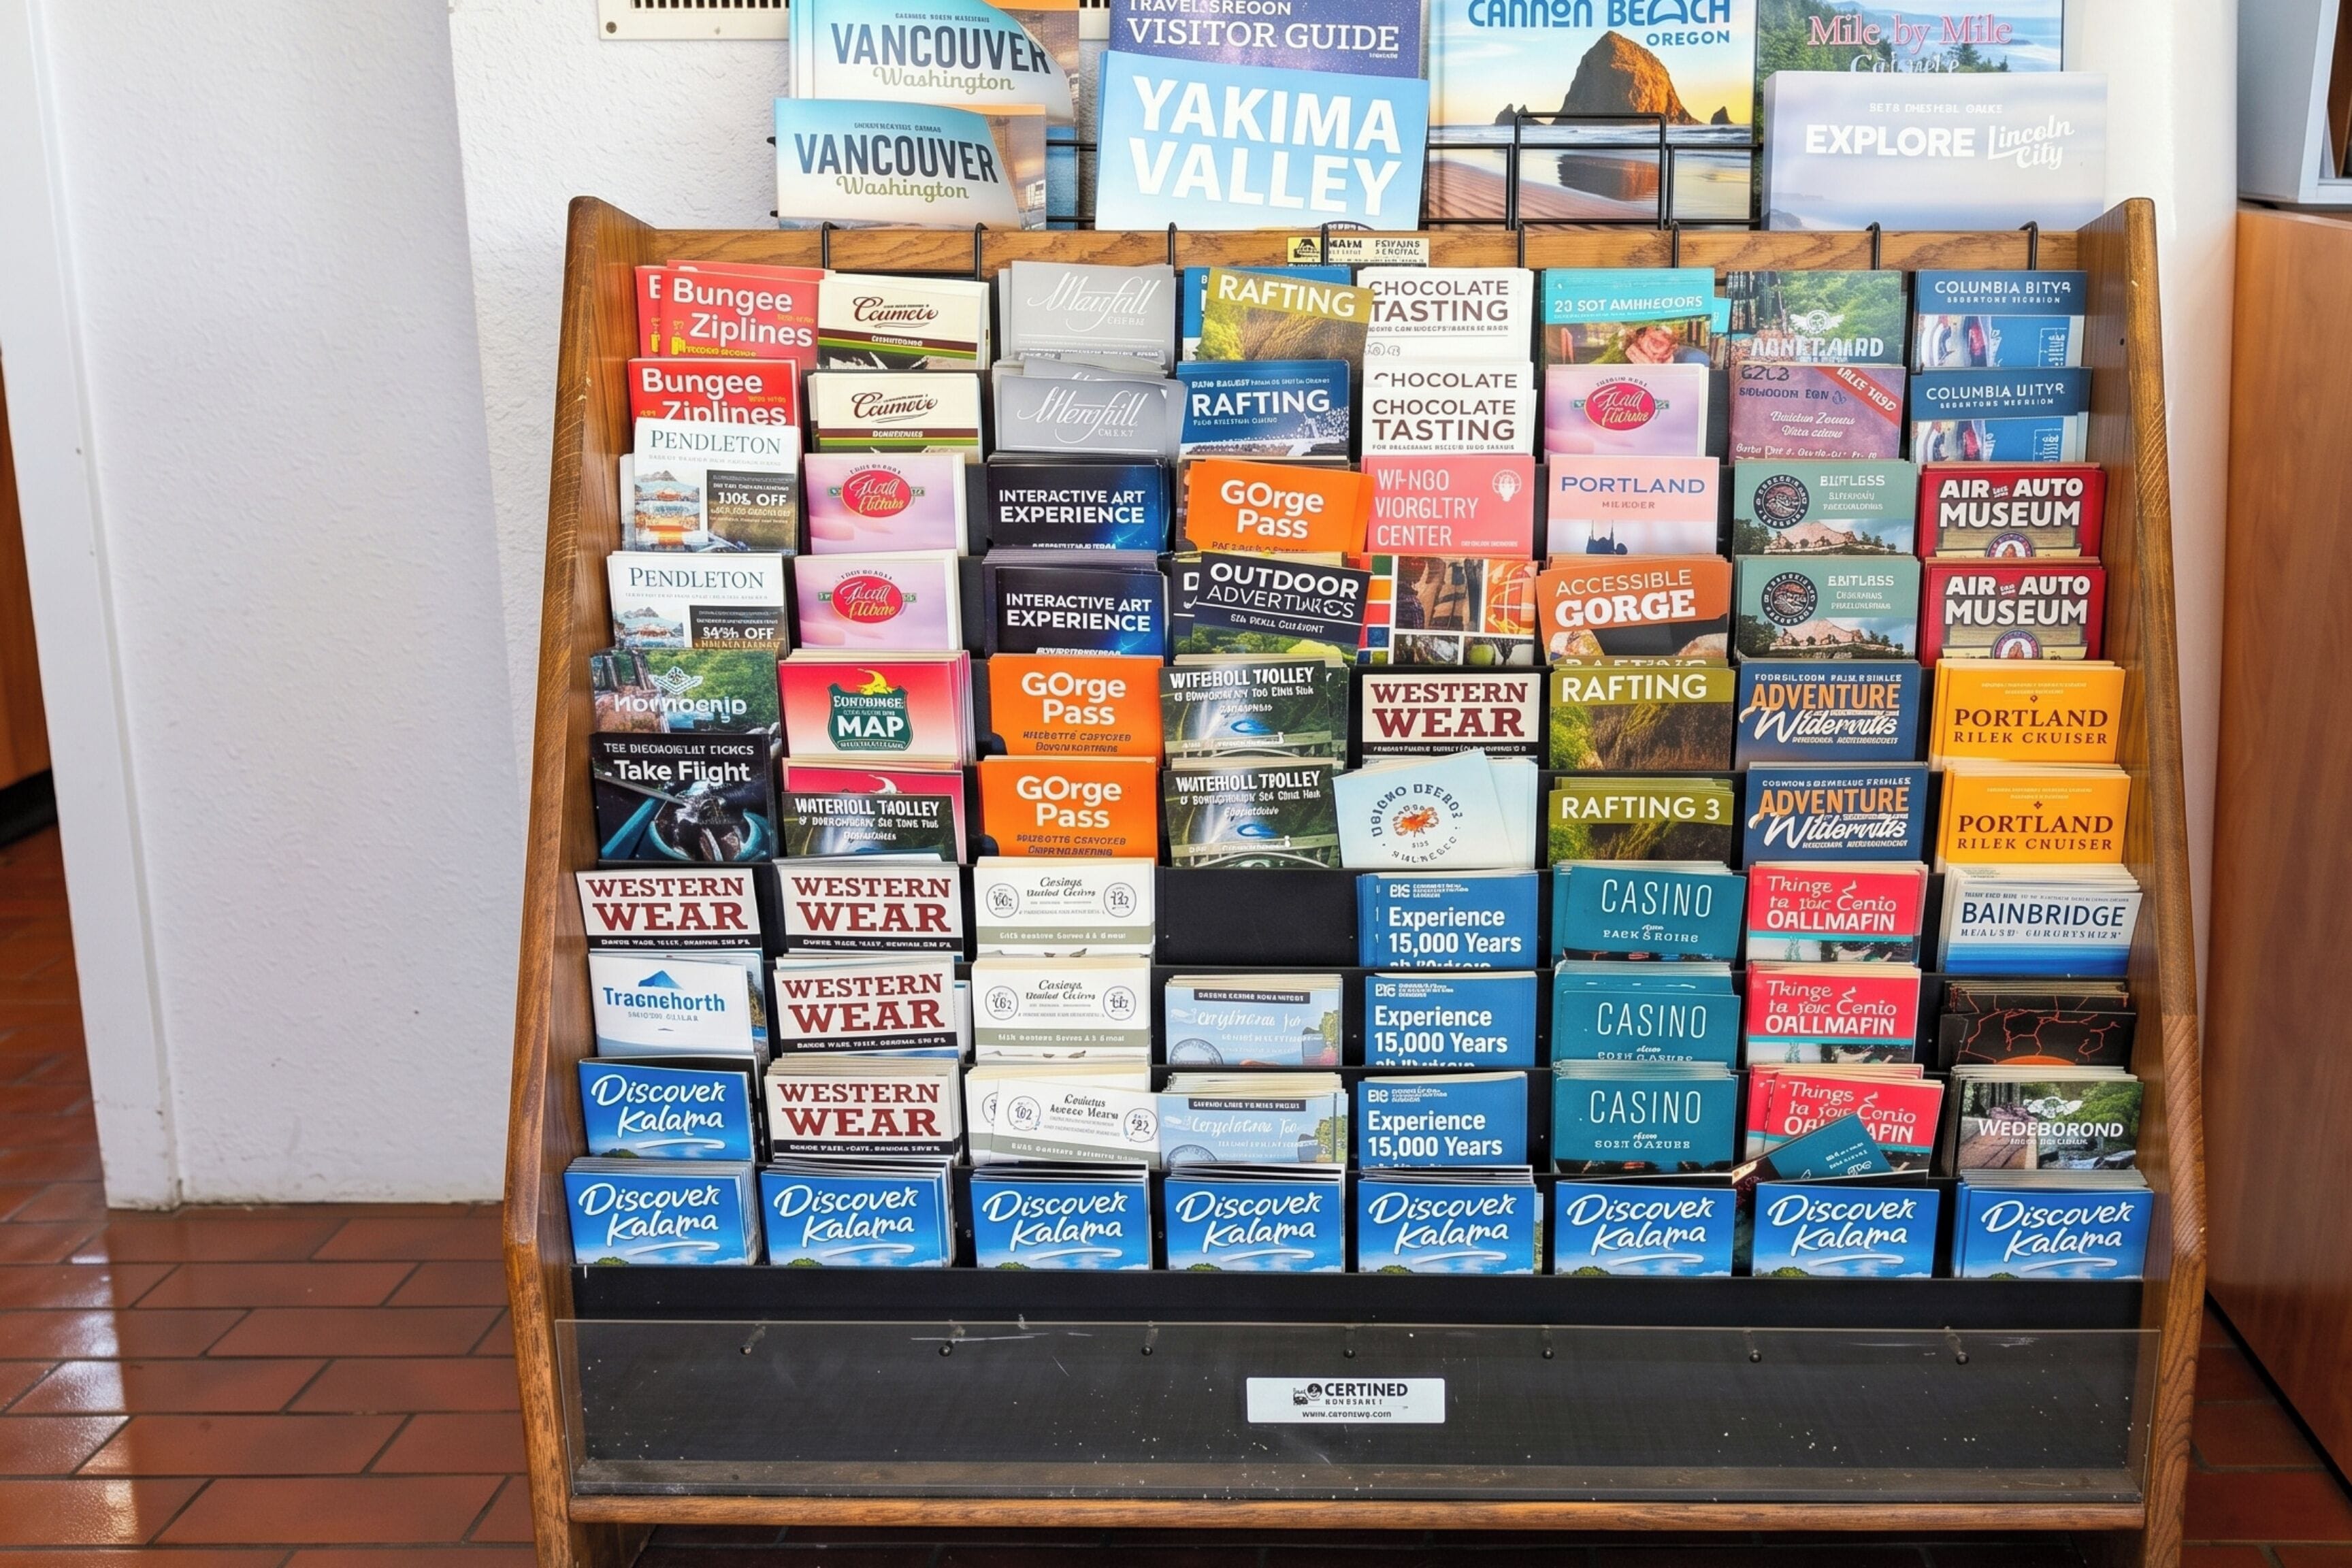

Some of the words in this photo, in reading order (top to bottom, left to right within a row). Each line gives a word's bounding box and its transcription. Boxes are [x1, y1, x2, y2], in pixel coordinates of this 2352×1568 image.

[1127, 18, 1277, 48] VISITOR
[1285, 24, 1400, 52] GUIDE
[1646, 31, 1730, 46] OREGON
[1808, 14, 1881, 46] Mile
[1893, 15, 1931, 54] by
[1938, 12, 2012, 44] Mile
[831, 22, 1051, 74] VANCOUVER
[873, 66, 1016, 95] Washington
[1132, 74, 1403, 154] YAKIMA
[1806, 124, 1975, 158] EXPLORE
[1988, 114, 2075, 161] Lincoln
[794, 133, 999, 184] VANCOUVER
[2016, 142, 2063, 170] City
[836, 175, 970, 203] Washington
[1128, 136, 1403, 216] VALLEY
[672, 277, 792, 317] Bungee
[1218, 274, 1356, 317] RAFTING
[1369, 280, 1509, 296] CHOCOLATE
[1934, 280, 2020, 295] COLUMBIA
[1371, 300, 1509, 322] TASTING
[689, 312, 813, 348] Ziplines
[641, 368, 763, 399] Bungee
[1926, 385, 2012, 400] COLUMBIA
[662, 402, 787, 426] Ziplines
[1192, 389, 1330, 417] RAFTING
[1372, 399, 1516, 415] CHOCOLATE
[651, 430, 781, 455] PENDLETON
[1372, 419, 1515, 442] TASTING
[999, 489, 1107, 504] INTERACTIVE
[1111, 490, 1145, 505] ART
[1220, 480, 1324, 513] GOrge
[1561, 476, 1705, 494] PORTLAND
[1939, 478, 1989, 499] AIR
[2012, 478, 2083, 498] AUTO
[756, 493, 787, 506] OFF
[1000, 505, 1145, 523] EXPERIENCE
[1237, 512, 1309, 539] Pass
[1939, 501, 2080, 528] MUSEUM
[1377, 525, 1452, 546] CENTER
[629, 567, 764, 591] PENDLETON
[1210, 563, 1359, 600] OUTDOOR
[1556, 570, 1693, 597] ACCESSIBLE
[1945, 576, 1996, 596] AIR
[2019, 576, 2091, 595] AUTO
[1006, 593, 1114, 610] INTERACTIVE
[1117, 598, 1153, 612] ART
[1555, 589, 1695, 627] GORGE
[1945, 599, 2087, 625] MUSEUM
[745, 627, 774, 640] OFF
[1007, 610, 1151, 633] EXPERIENCE
[1022, 672, 1126, 704] GOrge
[1371, 683, 1528, 704] WESTERN
[1562, 674, 1707, 702] RAFTING
[1750, 683, 1901, 710] ADVENTURE
[837, 715, 904, 738] MAP
[1042, 699, 1115, 726] Pass
[1372, 708, 1525, 738] WEAR
[1954, 708, 2108, 728] PORTLAND
[614, 759, 672, 780] Take
[1016, 775, 1122, 807] GOrge
[1759, 787, 1909, 817] ADVENTURE
[1036, 803, 1110, 828] Pass
[1562, 796, 1696, 820] RAFTING
[1705, 798, 1720, 820] 3
[1957, 815, 2114, 834] PORTLAND
[585, 877, 745, 898] WESTERN
[791, 877, 951, 898] WESTERN
[1601, 879, 1714, 918] CASINO
[592, 902, 749, 931] WEAR
[796, 902, 952, 932] WEAR
[1389, 906, 1505, 930] Experience
[1961, 902, 2127, 927] BAINBRIDGE
[1389, 932, 1458, 956] 15,000
[1466, 933, 1522, 953] Years
[782, 973, 943, 999] WESTERN
[787, 999, 945, 1034] WEAR
[1375, 1005, 1492, 1030] Experience
[1597, 1002, 1707, 1039] CASINO
[1374, 1031, 1446, 1056] 15,000
[1452, 1032, 1508, 1052] Years
[591, 1074, 727, 1107] Discover
[777, 1083, 941, 1104] WESTERN
[1590, 1090, 1702, 1124] CASINO
[617, 1105, 725, 1139] Kalama
[782, 1107, 942, 1137] WEAR
[1368, 1111, 1486, 1135] Experience
[1368, 1136, 1439, 1161] 15,000
[1446, 1137, 1503, 1157] Years
[578, 1183, 721, 1218] Discover
[773, 1184, 918, 1218] Discover
[982, 1190, 1128, 1223] Discover
[1175, 1191, 1322, 1223] Discover
[1368, 1192, 1518, 1224] Discover
[1567, 1193, 1714, 1226] Discover
[1767, 1194, 1916, 1226] Discover
[606, 1211, 719, 1247] Kalama
[1981, 1199, 2136, 1232] Discover
[802, 1213, 915, 1249] Kalama
[1009, 1217, 1123, 1254] Kalama
[1203, 1218, 1317, 1254] Kalama
[1394, 1222, 1509, 1256] Kalama
[1590, 1222, 1707, 1257] Kalama
[1791, 1222, 1908, 1258] Kalama
[2004, 1227, 2123, 1262] Kalama
